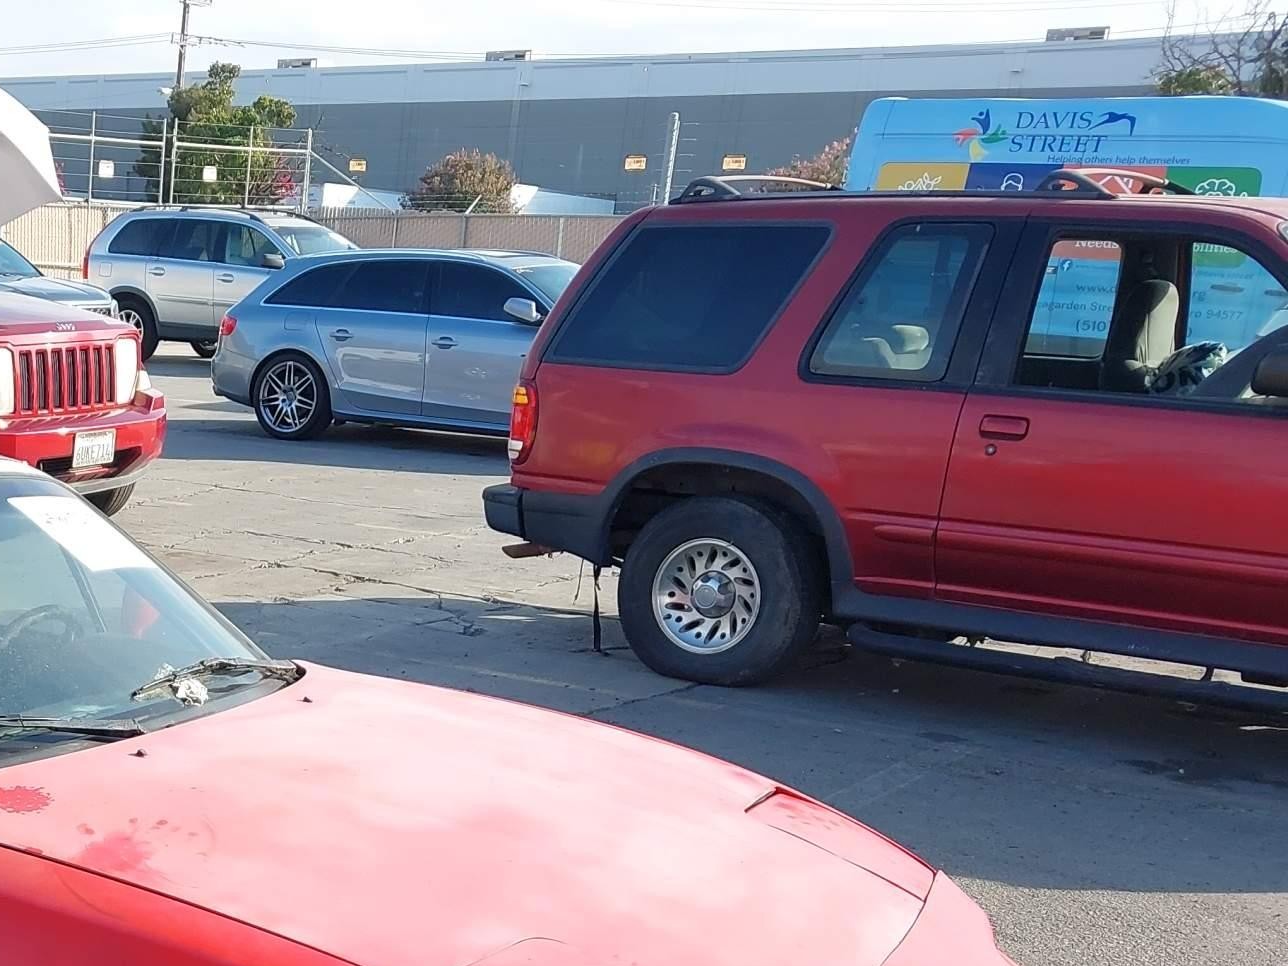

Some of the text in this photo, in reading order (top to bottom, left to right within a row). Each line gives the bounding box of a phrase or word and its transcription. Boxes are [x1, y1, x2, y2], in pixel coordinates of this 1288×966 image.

[1016, 111, 1094, 129] DAVIS
[1009, 135, 1108, 153] STREET
[1047, 154, 1191, 167] Helping others help themselves
